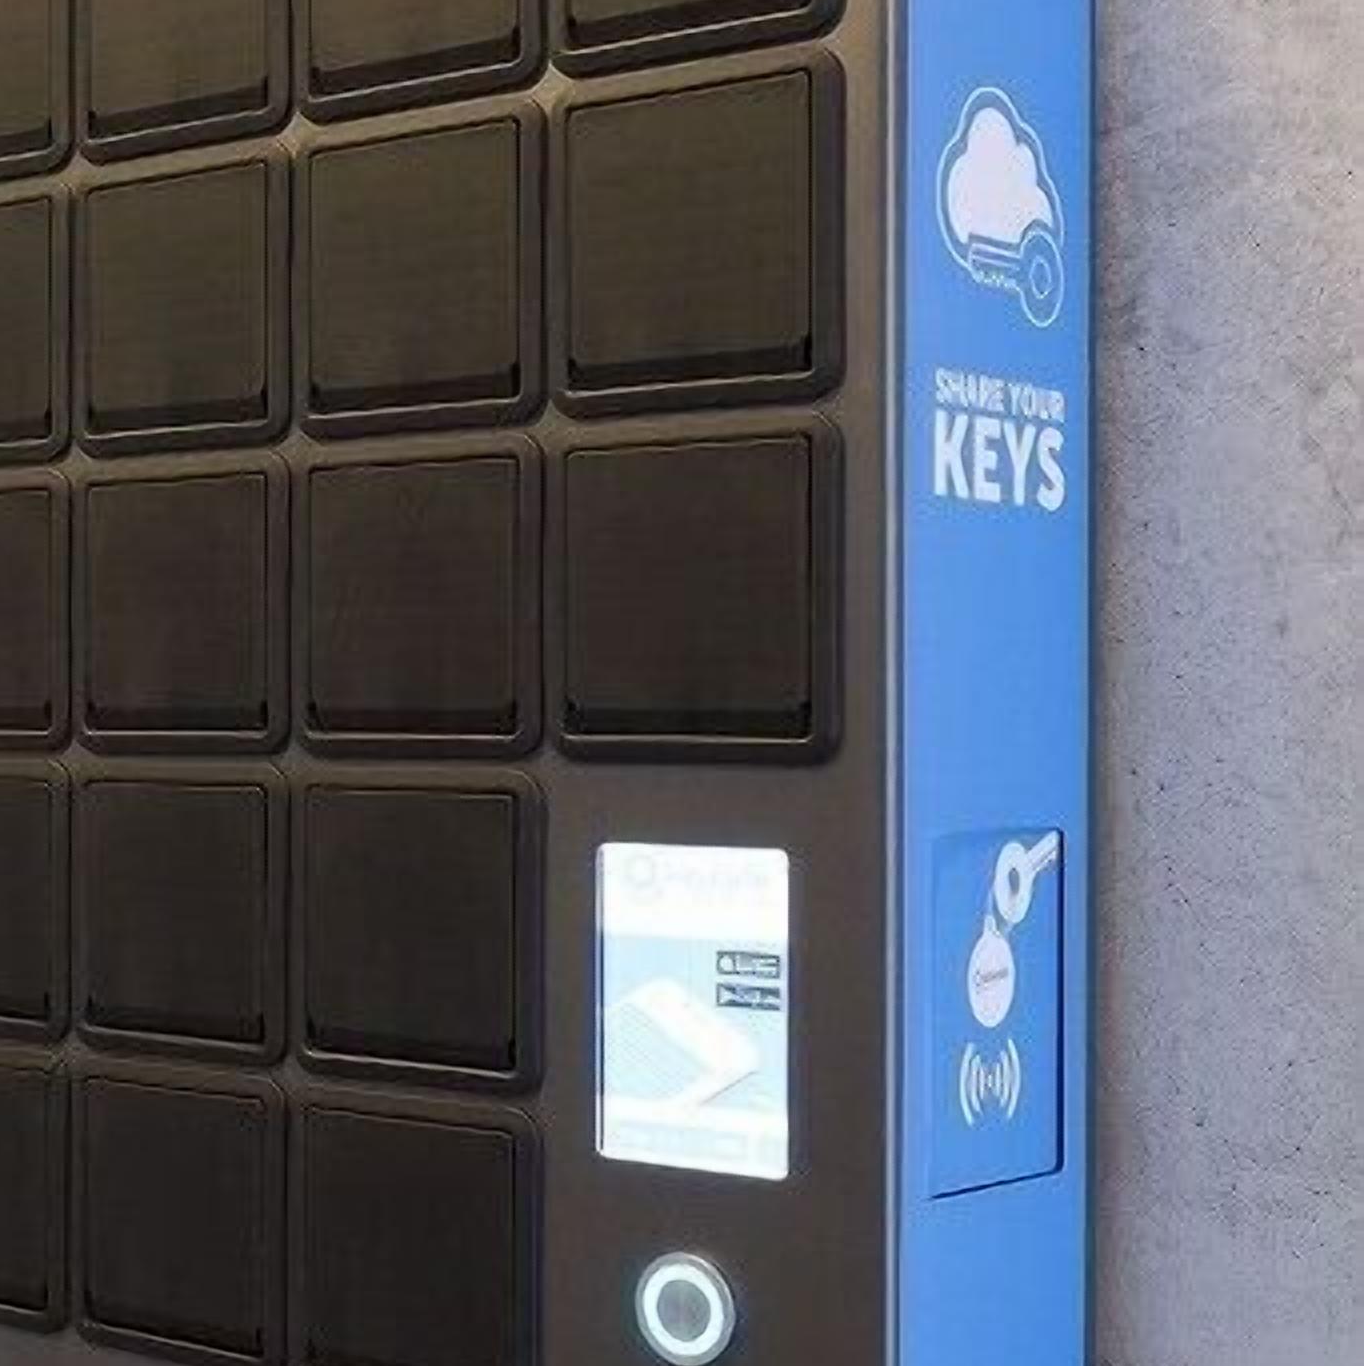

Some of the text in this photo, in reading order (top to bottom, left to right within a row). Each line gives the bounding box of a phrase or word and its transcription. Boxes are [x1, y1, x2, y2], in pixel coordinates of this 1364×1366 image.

[935, 367, 1065, 423] SHARE YOUR
[933, 409, 1066, 512] KEYS
